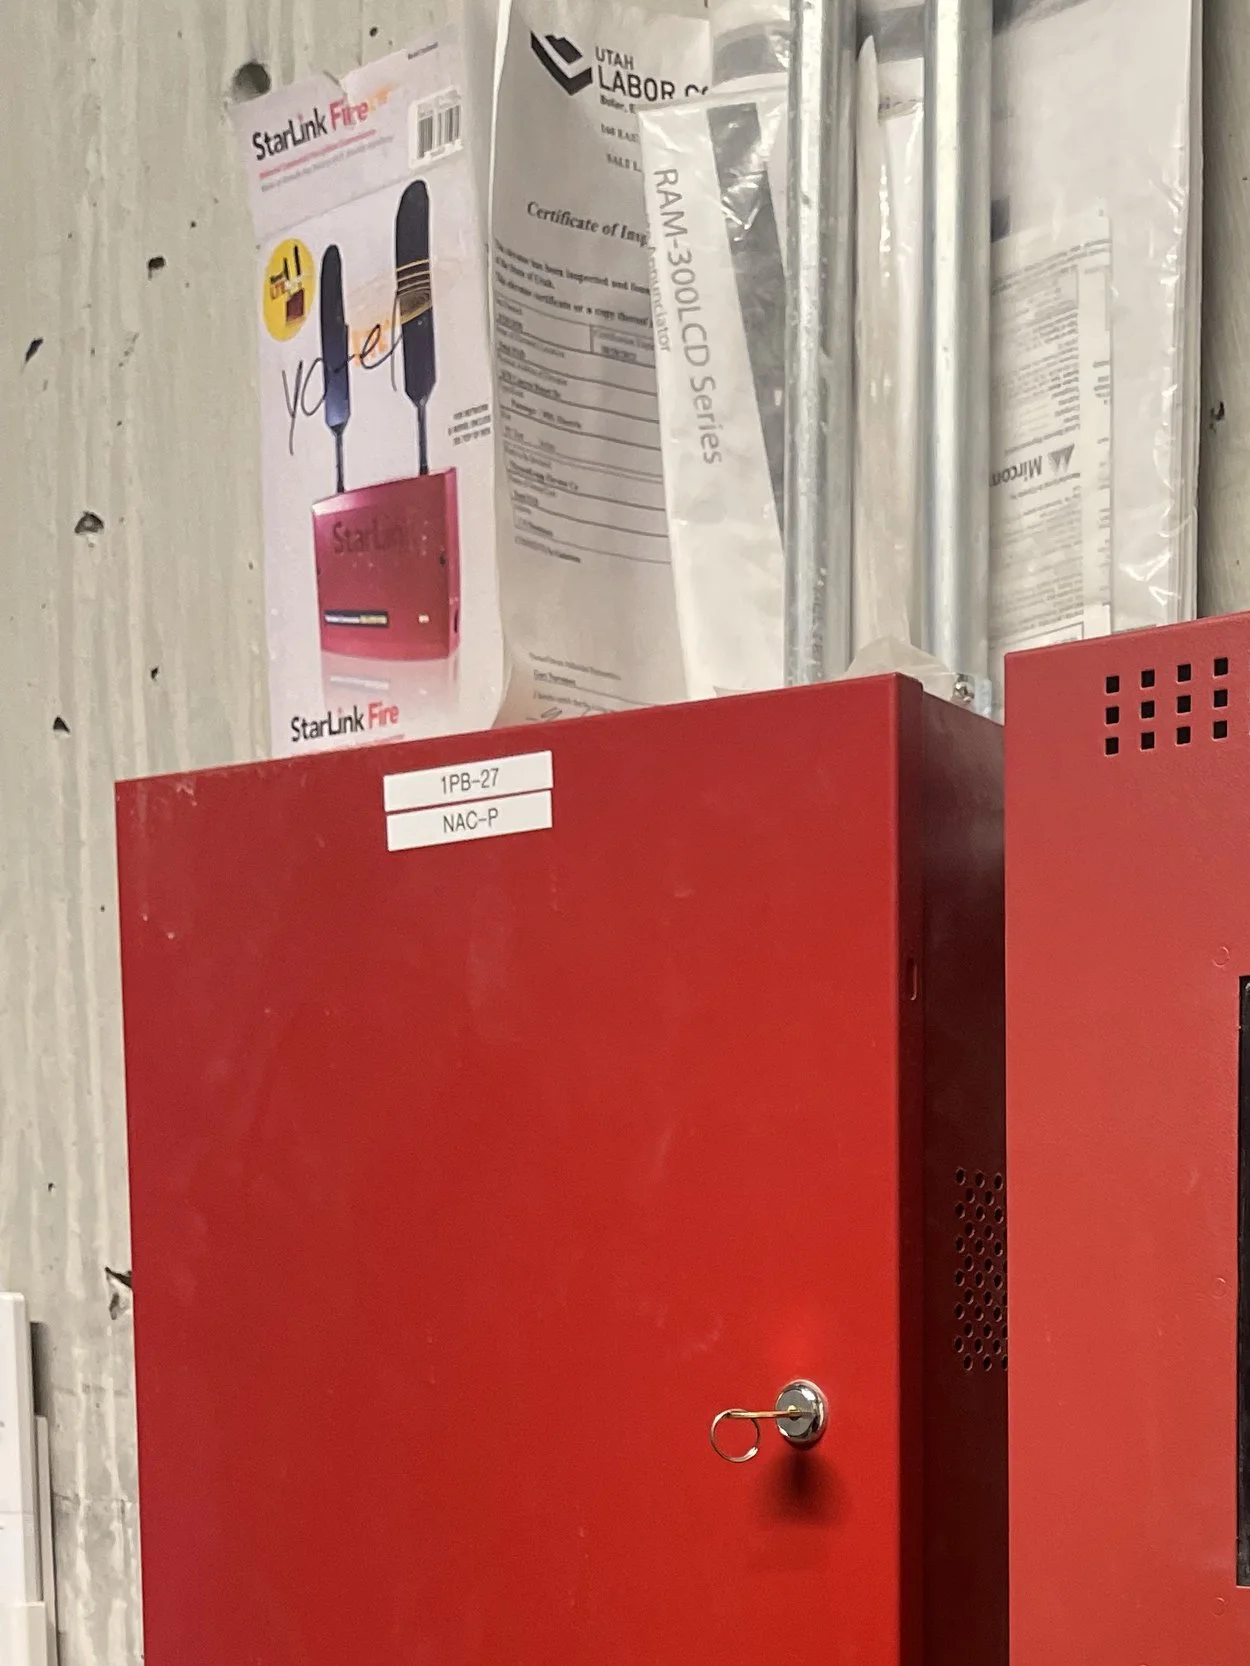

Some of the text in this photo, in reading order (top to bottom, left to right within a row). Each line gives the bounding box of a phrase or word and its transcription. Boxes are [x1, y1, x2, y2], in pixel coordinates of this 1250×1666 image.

[595, 46, 634, 70] UTAH
[598, 65, 676, 102] LABOR
[252, 108, 328, 161] StarLink
[328, 97, 370, 130] Fire
[527, 200, 621, 237] Certificate of
[653, 168, 723, 465] RAM-300LCD Series
[291, 706, 365, 743] StarLink
[367, 700, 399, 731] Fire
[441, 767, 500, 796] 1PB-27
[443, 807, 499, 834] NAC-P
